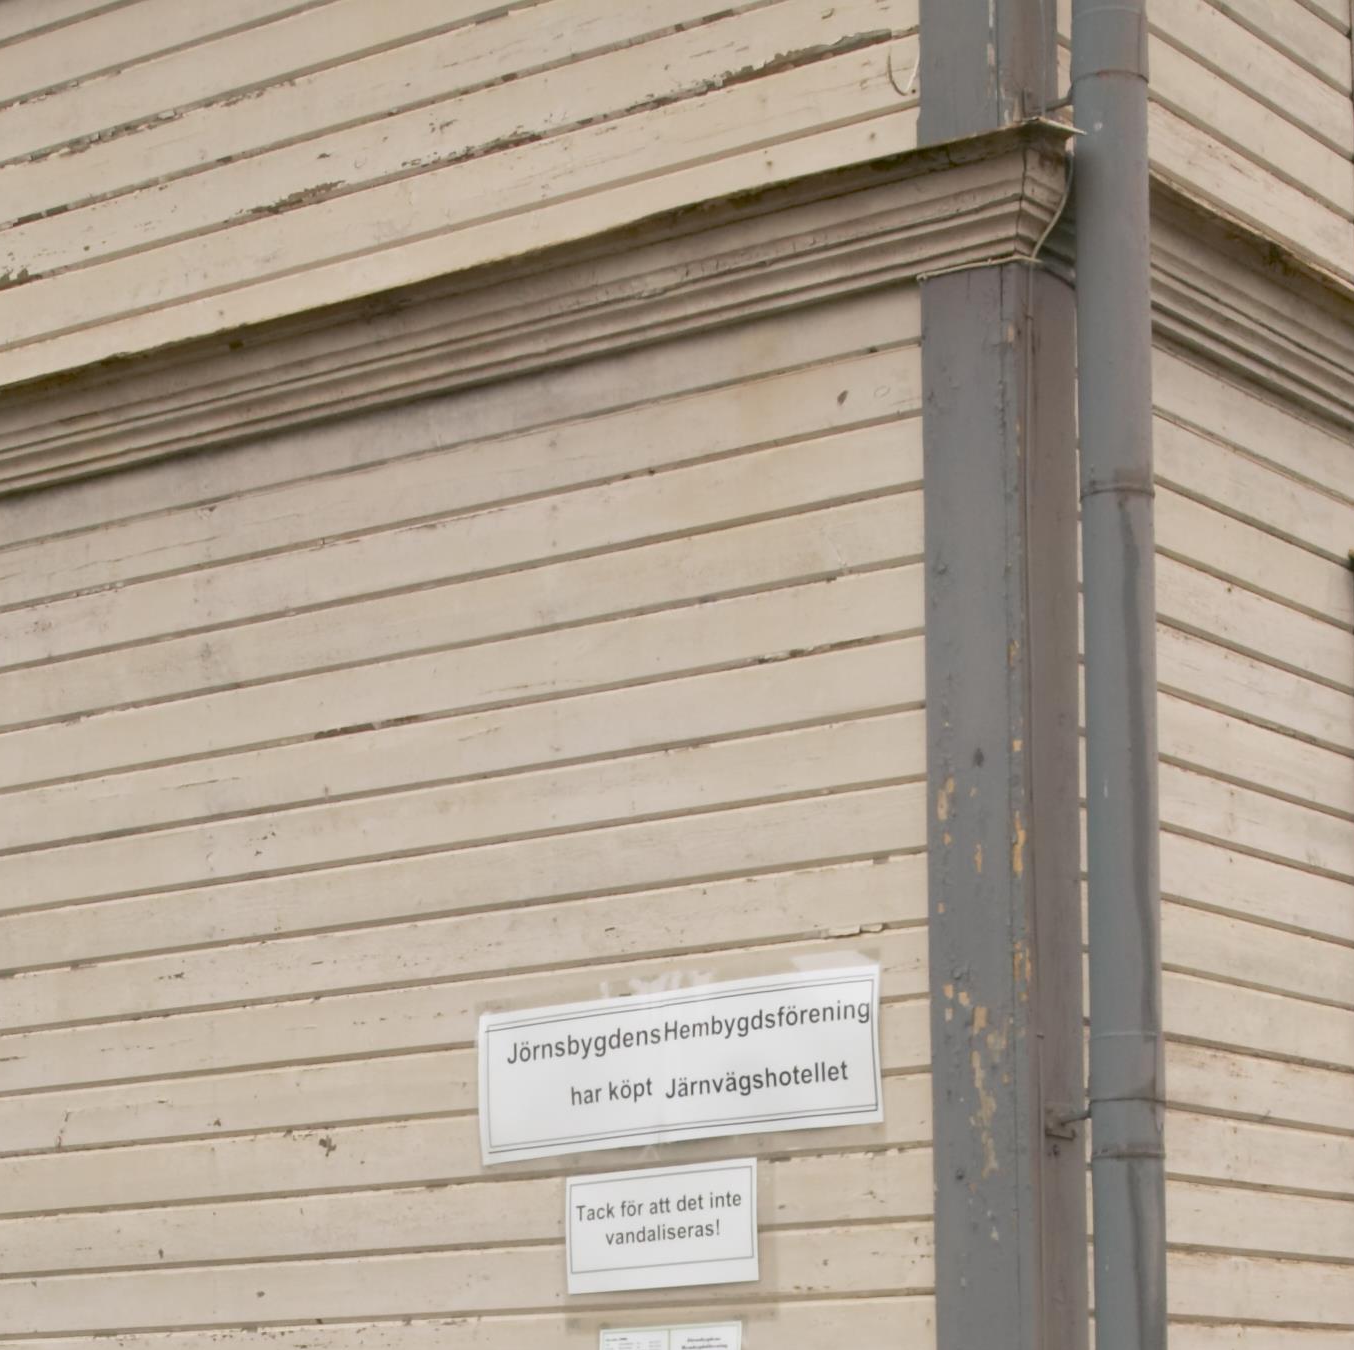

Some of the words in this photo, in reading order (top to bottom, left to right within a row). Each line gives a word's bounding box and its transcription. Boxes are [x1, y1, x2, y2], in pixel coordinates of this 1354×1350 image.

[571, 1085, 602, 1106] har
[609, 1076, 653, 1102] köpt
[665, 1060, 849, 1099] Järnvägshotellet
[576, 1205, 615, 1221] Tack
[621, 1200, 643, 1218] för
[649, 1198, 671, 1213] att
[676, 1195, 704, 1212] det
[709, 1191, 742, 1208] inte
[605, 1219, 721, 1246] vandaliseras!
